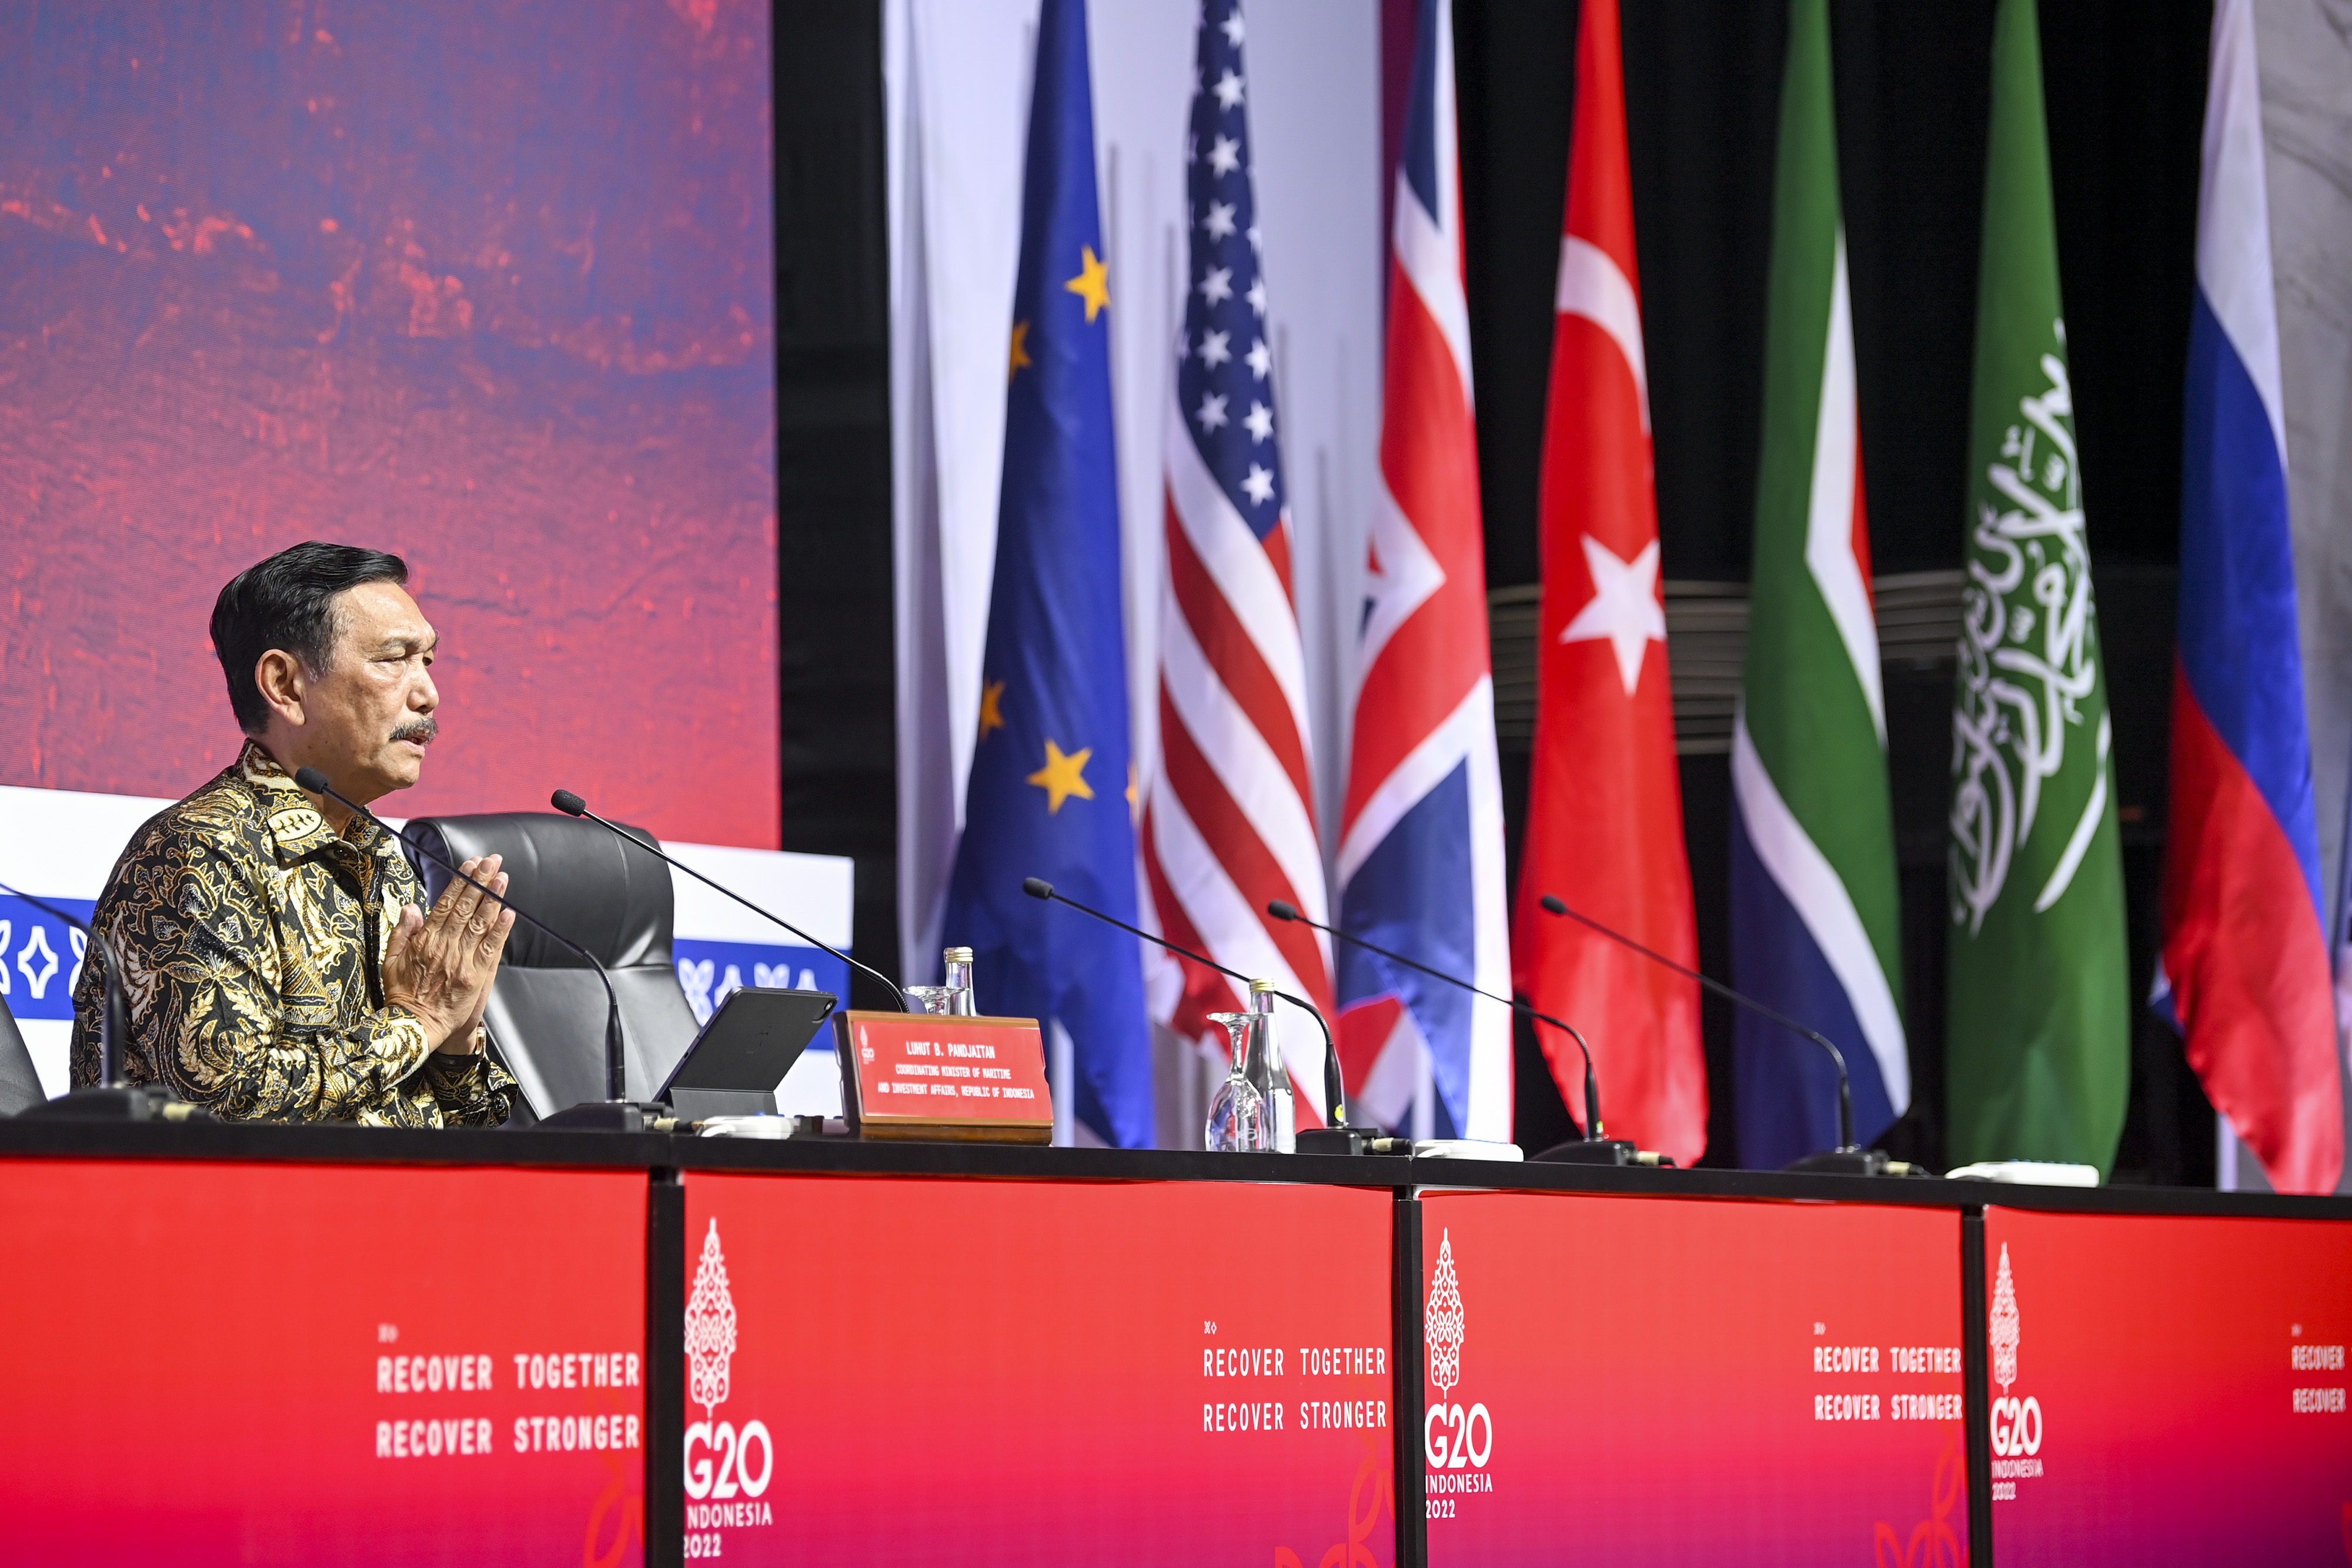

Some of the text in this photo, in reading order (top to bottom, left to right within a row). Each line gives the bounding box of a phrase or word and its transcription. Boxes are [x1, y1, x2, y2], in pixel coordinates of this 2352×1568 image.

[906, 1041, 995, 1059] LUHUT B. PANDJAITAN
[896, 1064, 1011, 1079] COORDINATING MINISTER OF MARITIME
[878, 1082, 1035, 1099] AND INVESTMENT AFFAIRS, REPUBLIC OF INDONESIA
[1204, 1347, 1385, 1377] RECOVER TOGETHER
[1813, 1346, 1962, 1373] RECOVER TOGETHER
[2291, 1345, 2345, 1370] RECOVER
[377, 1352, 640, 1393] RECOVER TOGETHER
[1815, 1394, 1963, 1420] RECOVER STRONGER
[2293, 1388, 2346, 1413] RECOVER
[1204, 1400, 1387, 1432] RECOVER STRONGER
[1990, 1396, 2043, 1456] G20
[376, 1414, 640, 1457] RECOVER STRONGER
[1424, 1402, 1492, 1469] G20
[683, 1419, 773, 1500] G20
[1991, 1459, 2044, 1479] INDONESIA
[1425, 1473, 1493, 1494] INDONESIA
[687, 1501, 773, 1529] NDONESIA
[1425, 1499, 1455, 1519] 2022
